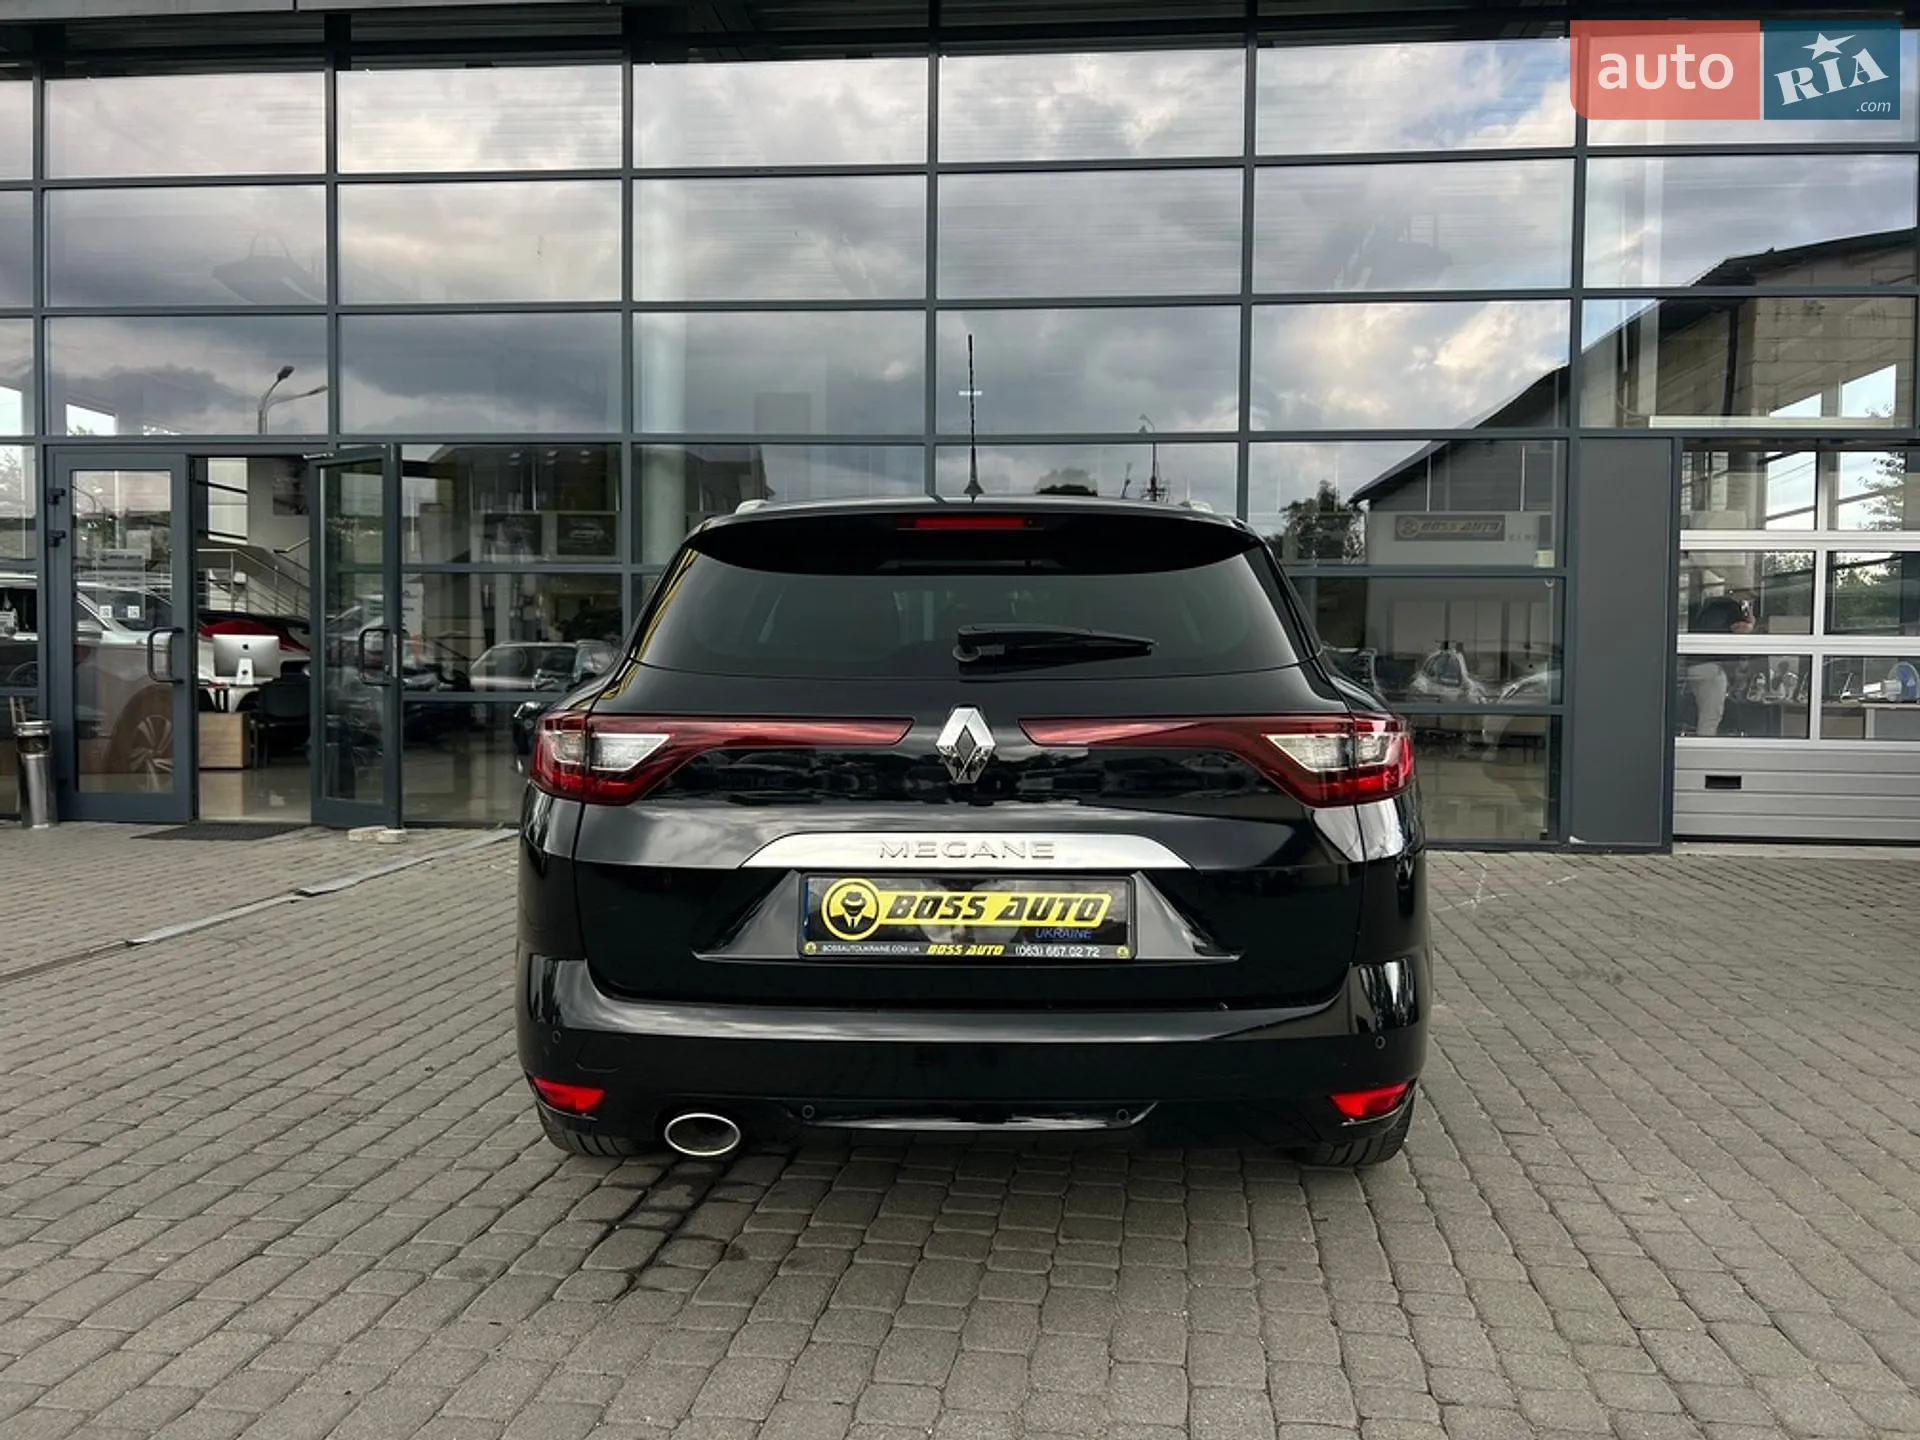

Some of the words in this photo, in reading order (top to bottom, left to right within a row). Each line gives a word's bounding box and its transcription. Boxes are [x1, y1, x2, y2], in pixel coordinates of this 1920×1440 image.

[879, 840, 1056, 859] MEGANE
[886, 894, 987, 920] BOSS
[994, 895, 1106, 922] AUTO
[1035, 927, 1092, 939] UKRAINE
[926, 944, 963, 956] BOSS
[965, 944, 1006, 956] AUTO
[1087, 946, 1101, 957] 72
